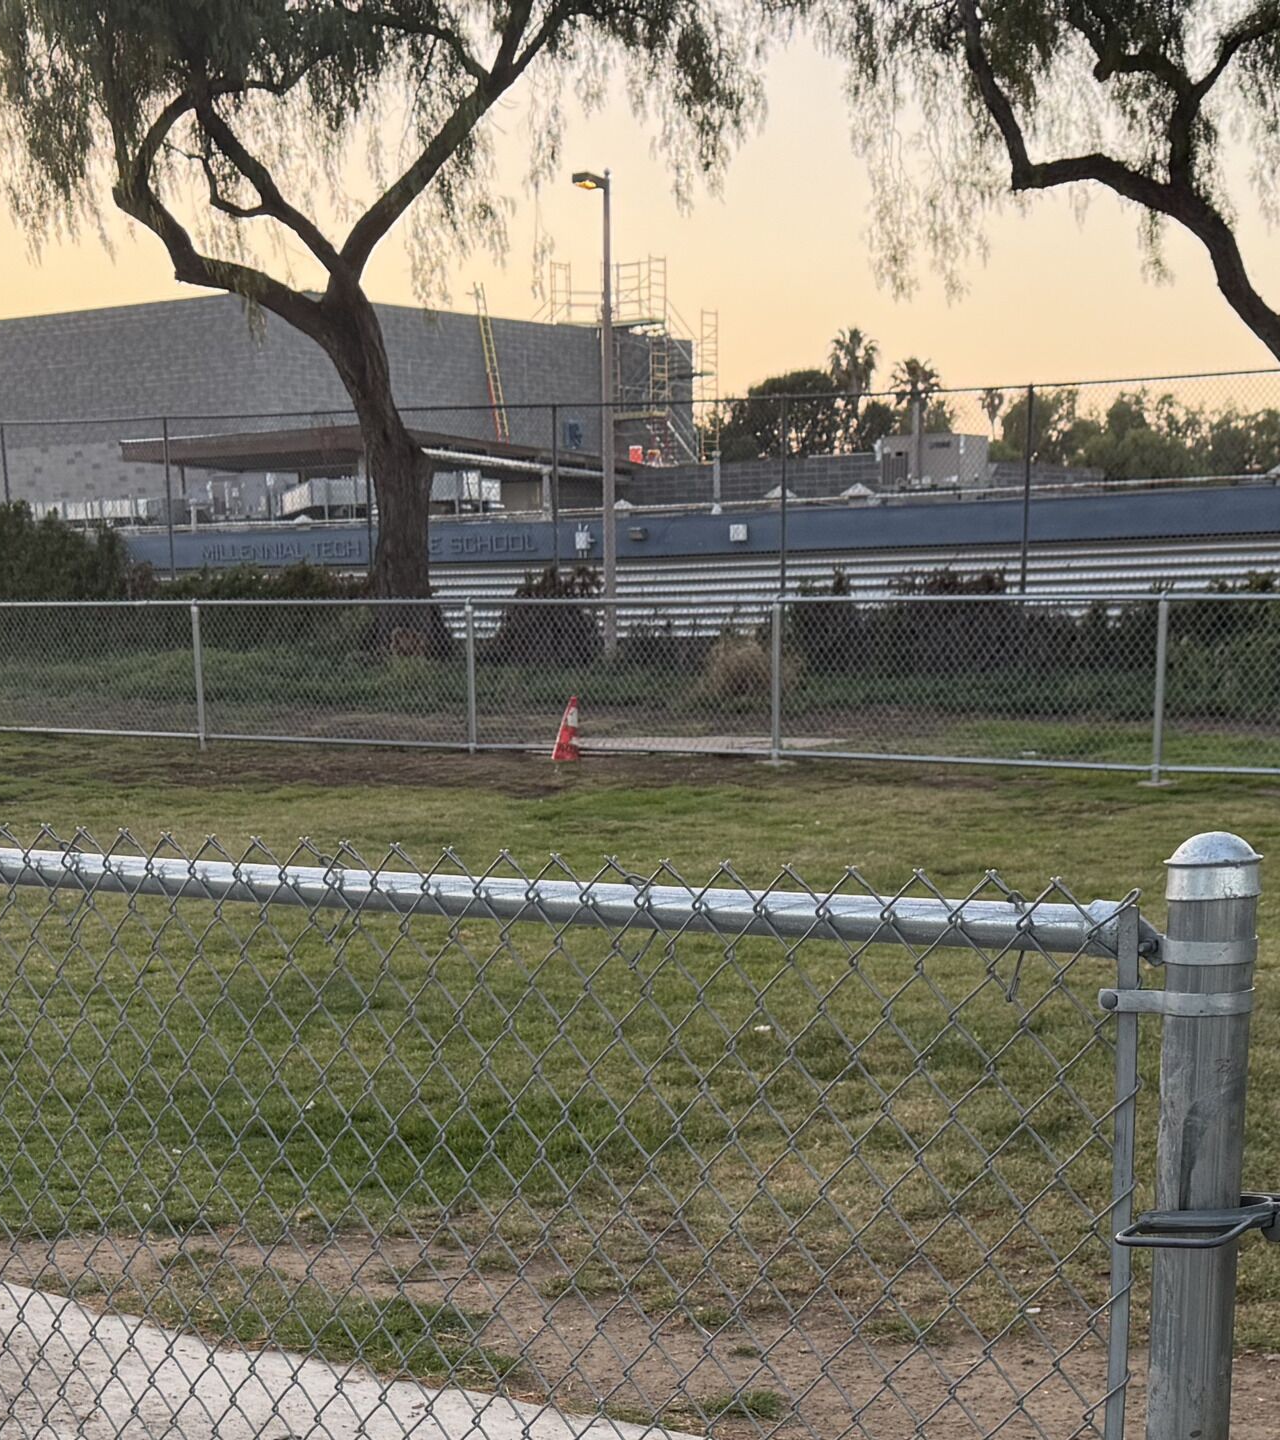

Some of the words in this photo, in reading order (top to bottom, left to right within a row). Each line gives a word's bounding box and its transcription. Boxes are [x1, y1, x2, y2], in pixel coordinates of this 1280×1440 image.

[201, 541, 303, 561] MILLENNIAL
[311, 539, 362, 558] TECH
[450, 533, 538, 554] SCHOOL
